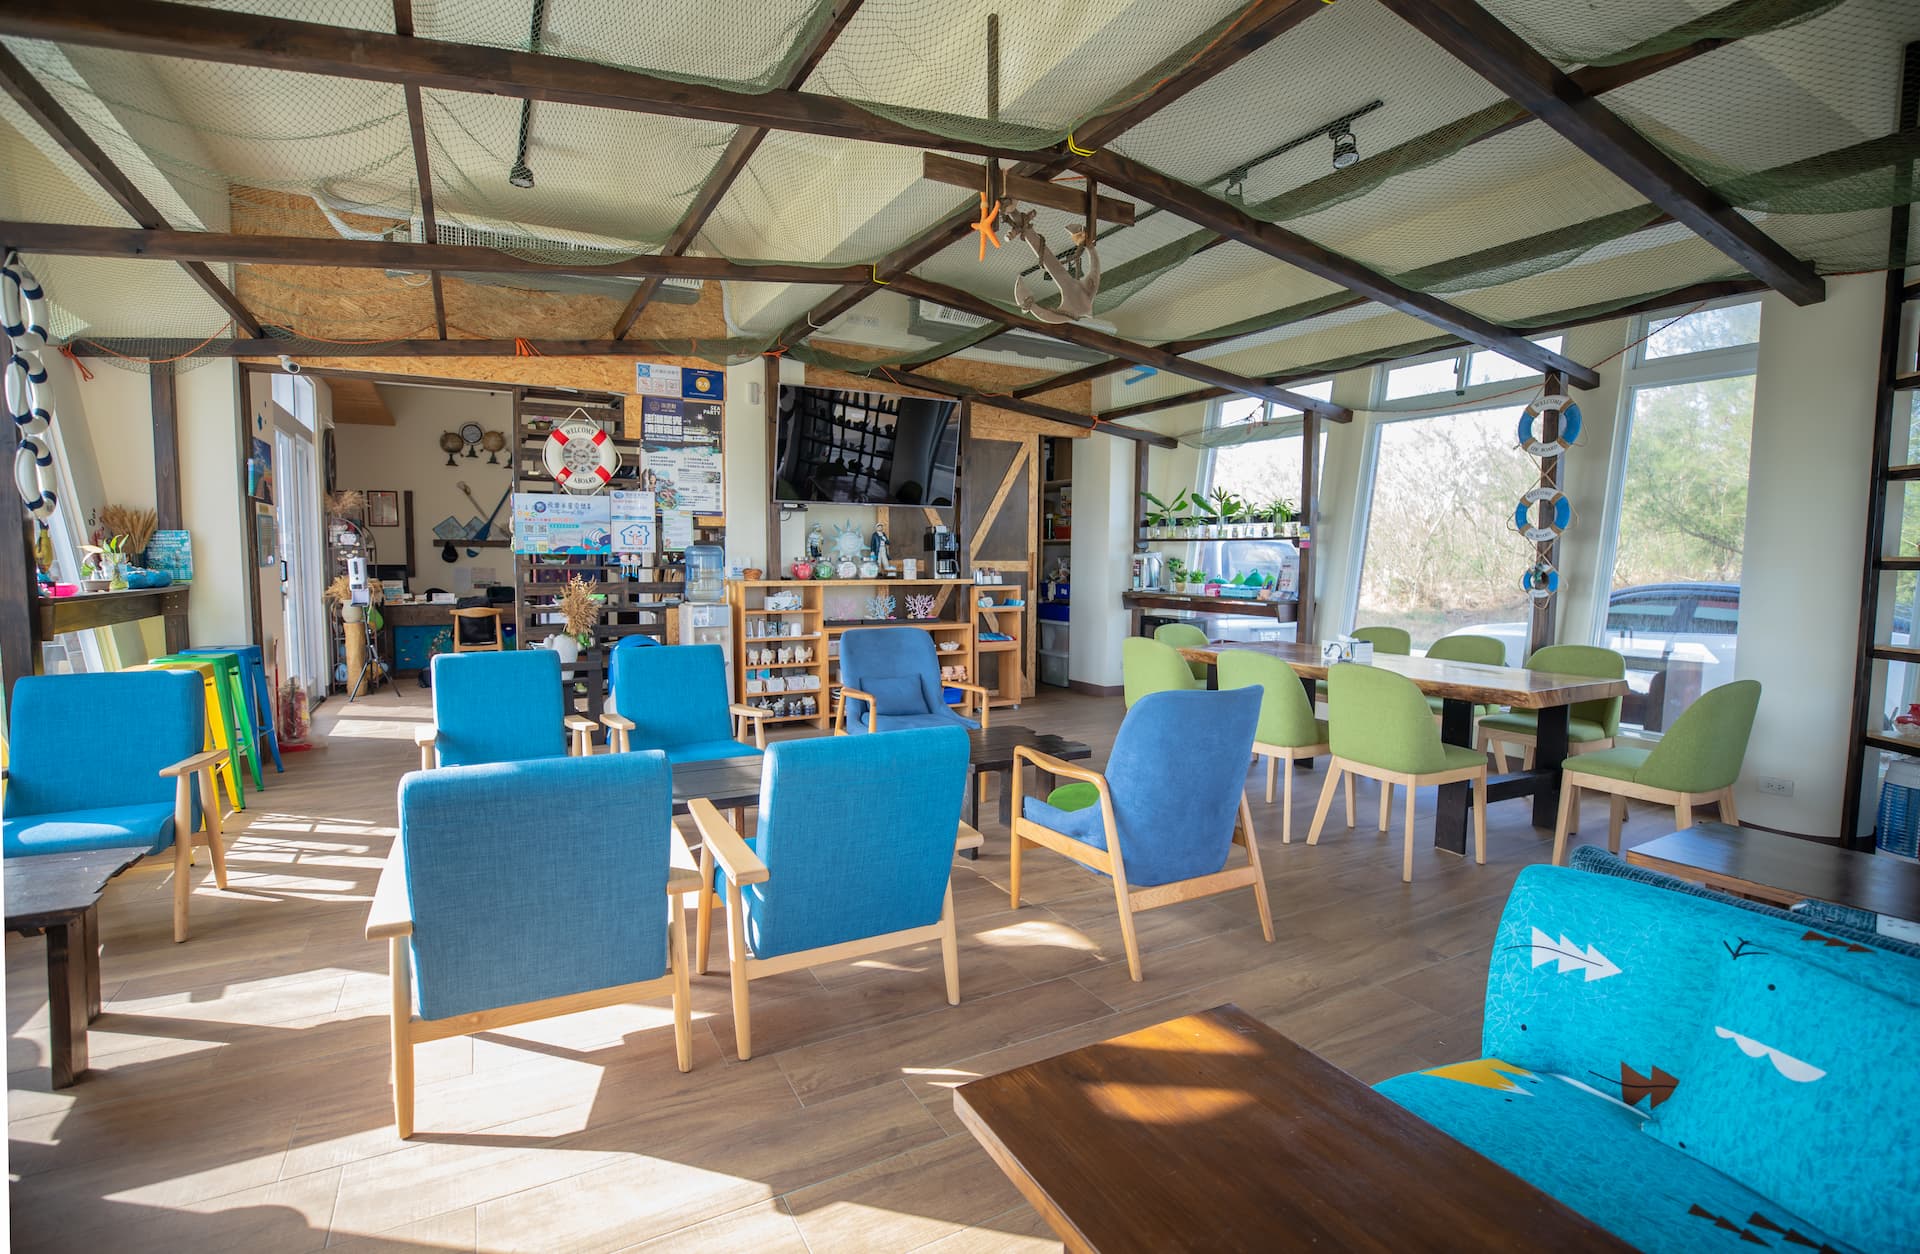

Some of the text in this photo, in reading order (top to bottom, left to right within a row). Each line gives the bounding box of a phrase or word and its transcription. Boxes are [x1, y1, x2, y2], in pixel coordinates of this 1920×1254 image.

[1534, 399, 1562, 407] WELCOME
[565, 427, 594, 435] WELCOME
[1541, 444, 1559, 452] BOARD
[574, 476, 596, 484] ABOARD
